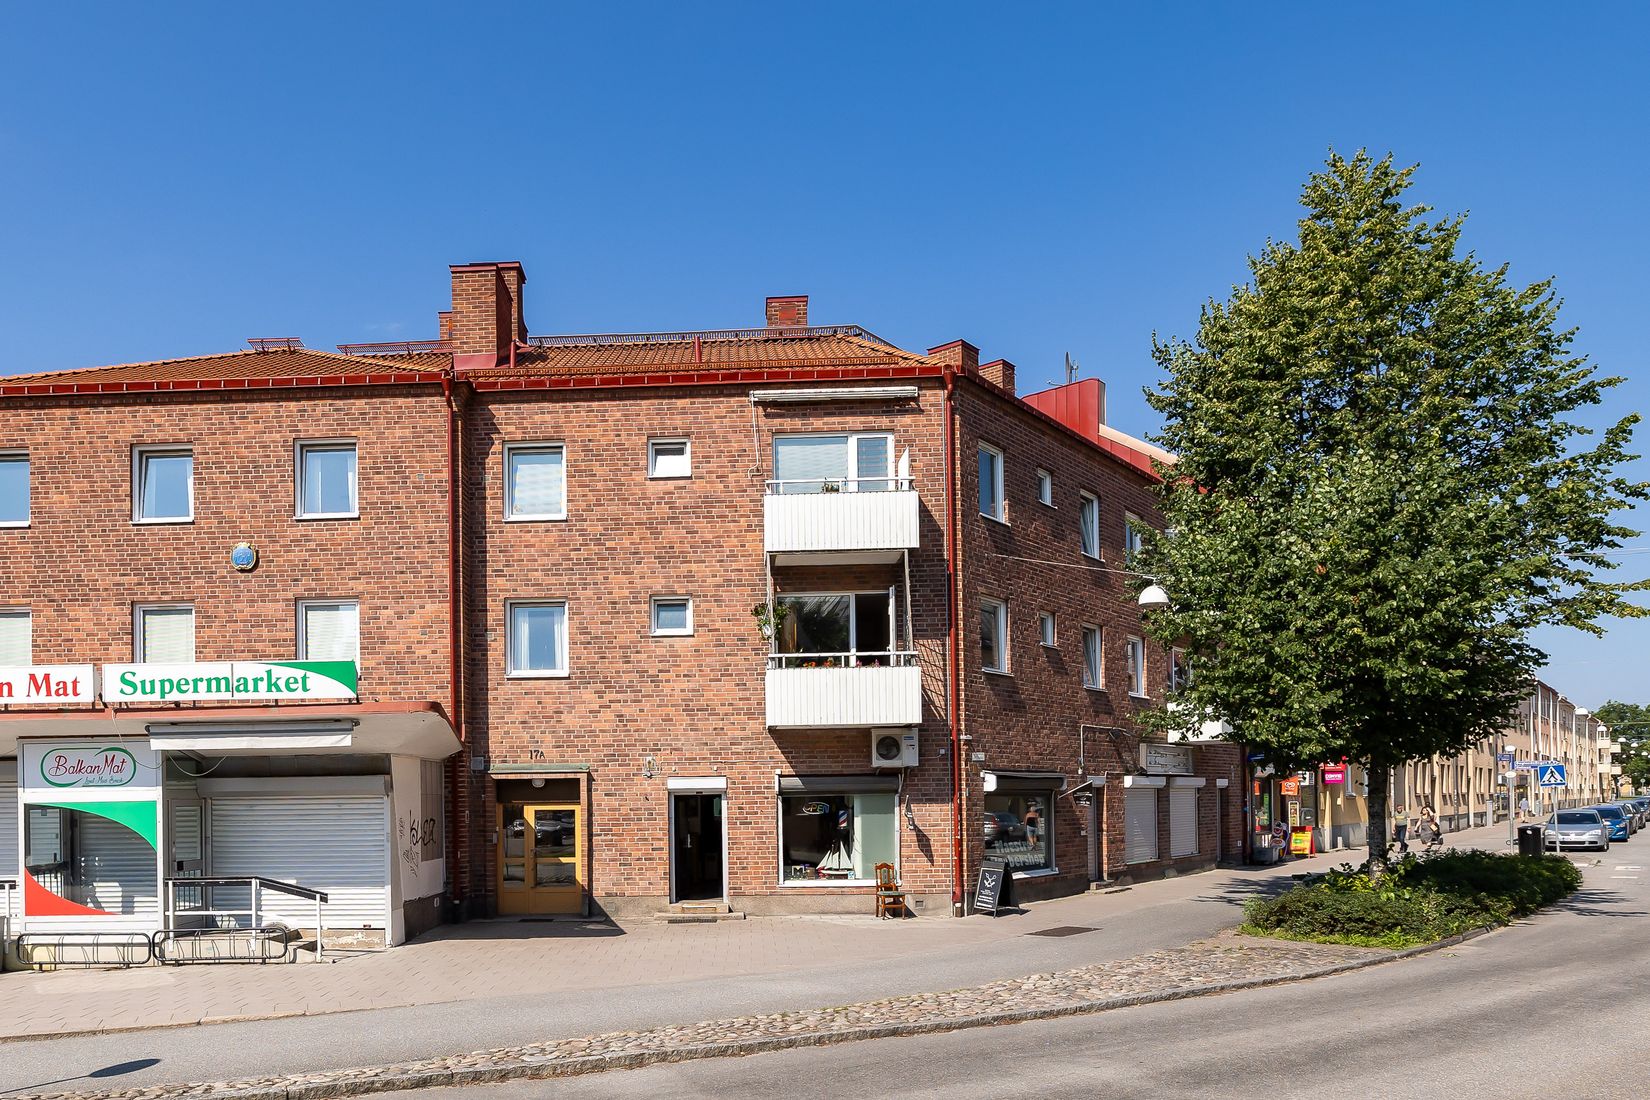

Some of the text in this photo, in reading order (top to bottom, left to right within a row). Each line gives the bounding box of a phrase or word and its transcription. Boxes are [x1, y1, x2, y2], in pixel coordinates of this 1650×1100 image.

[26, 673, 81, 698] Mat
[119, 668, 311, 699] Supermarket
[48, 754, 127, 777] Balkan Mat
[530, 749, 546, 760] 17A
